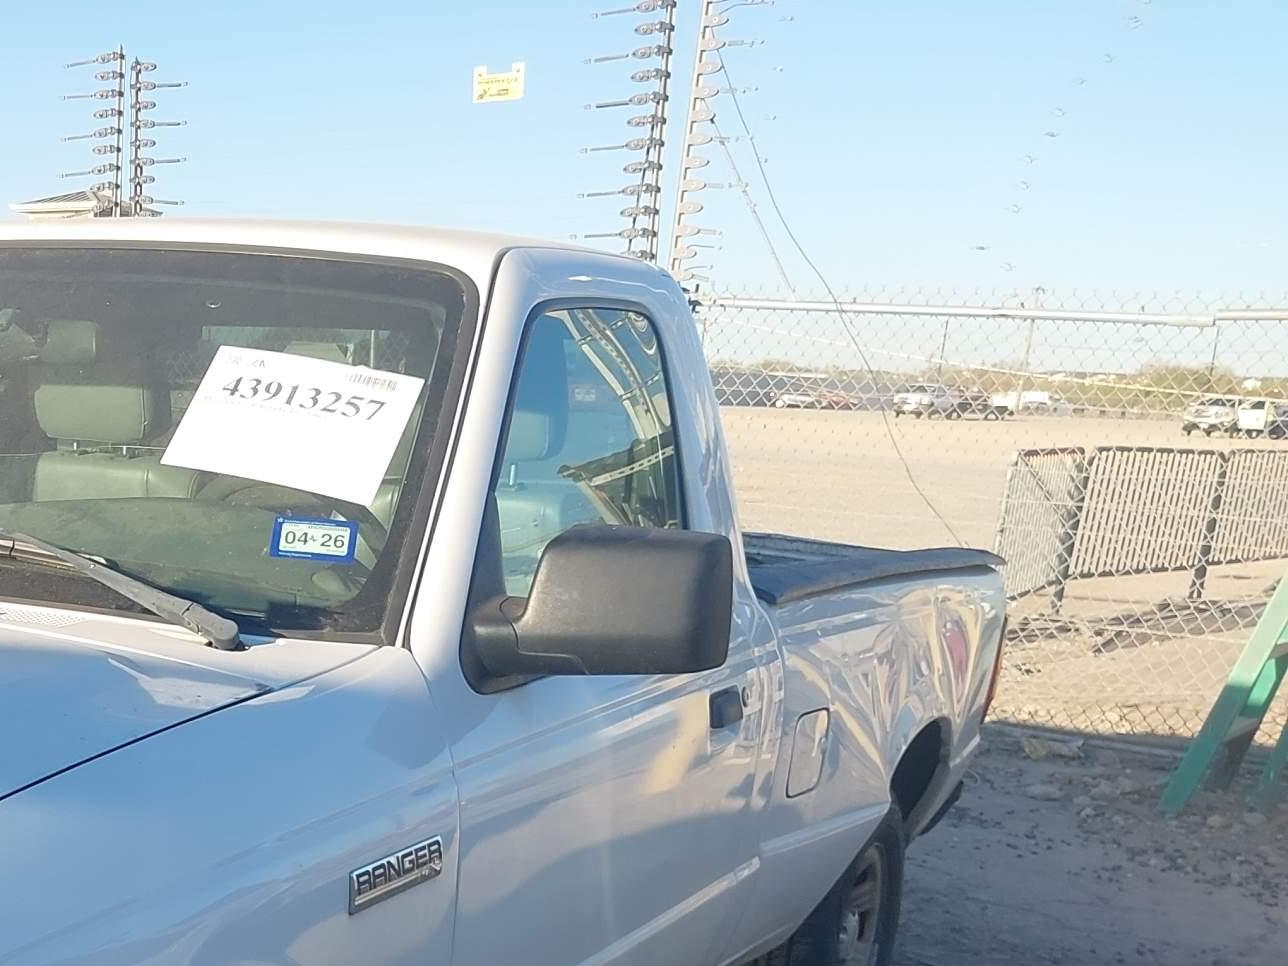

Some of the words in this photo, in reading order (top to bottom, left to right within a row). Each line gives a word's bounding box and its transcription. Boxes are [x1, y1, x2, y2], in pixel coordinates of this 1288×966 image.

[222, 376, 387, 421] 43913257
[284, 530, 309, 545] 04
[320, 533, 345, 549] 26
[355, 840, 442, 895] RANGER
